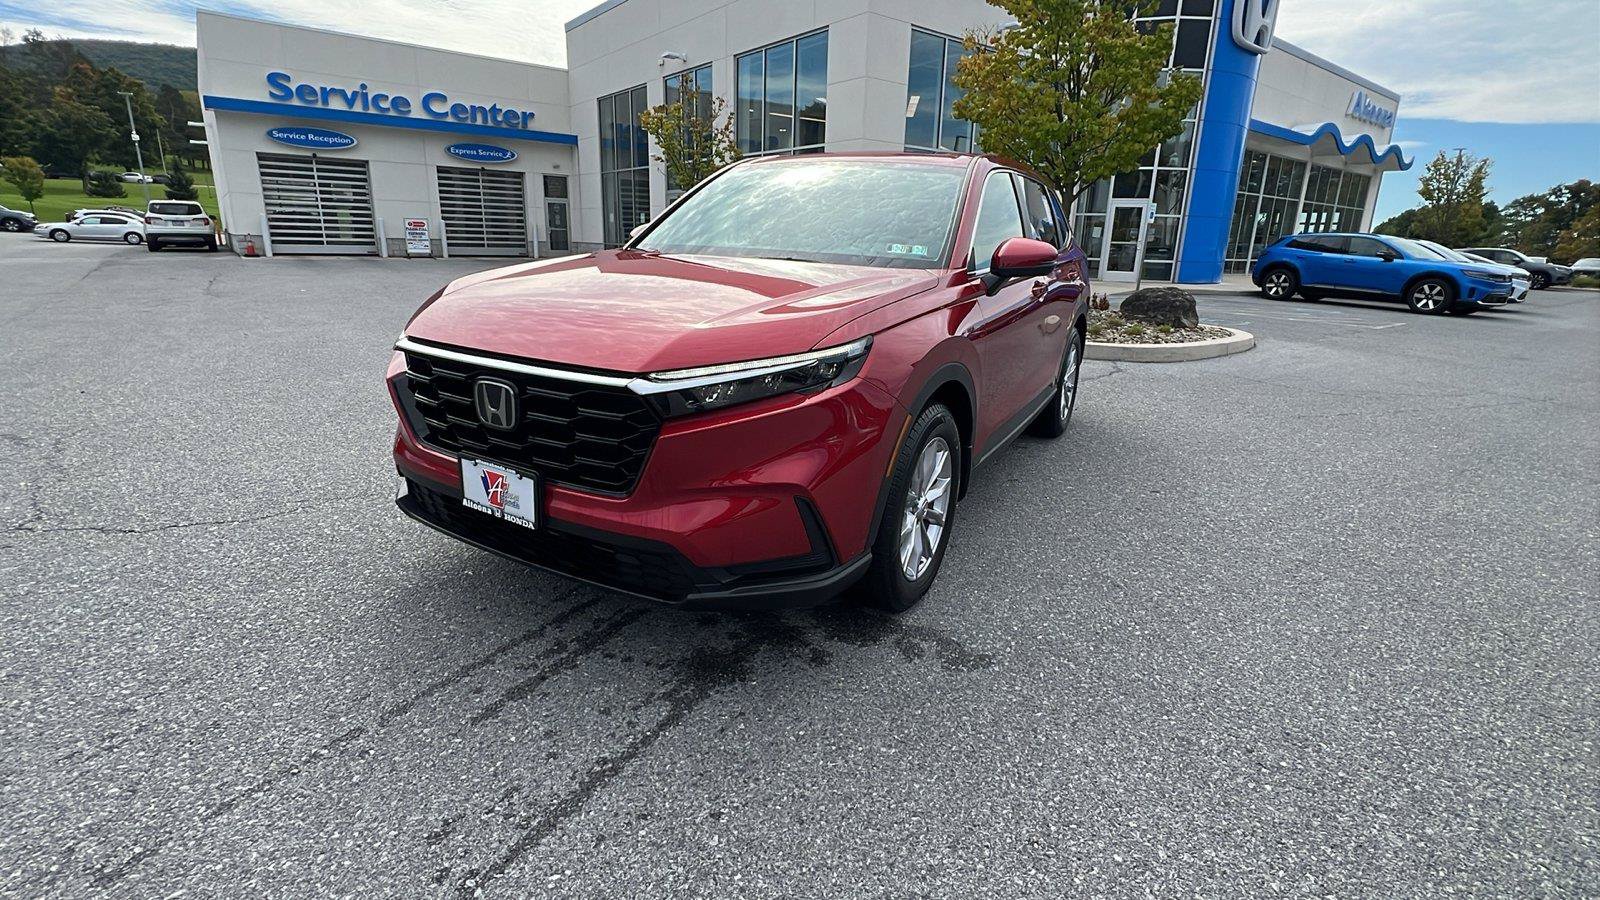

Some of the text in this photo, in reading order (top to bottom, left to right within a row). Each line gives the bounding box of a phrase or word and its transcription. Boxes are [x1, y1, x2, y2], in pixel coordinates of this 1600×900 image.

[266, 71, 536, 129] Service Center
[272, 130, 352, 144] Service Reception
[450, 146, 503, 157] Express Service
[462, 498, 493, 515] Altoona
[504, 512, 535, 530] HONDA
